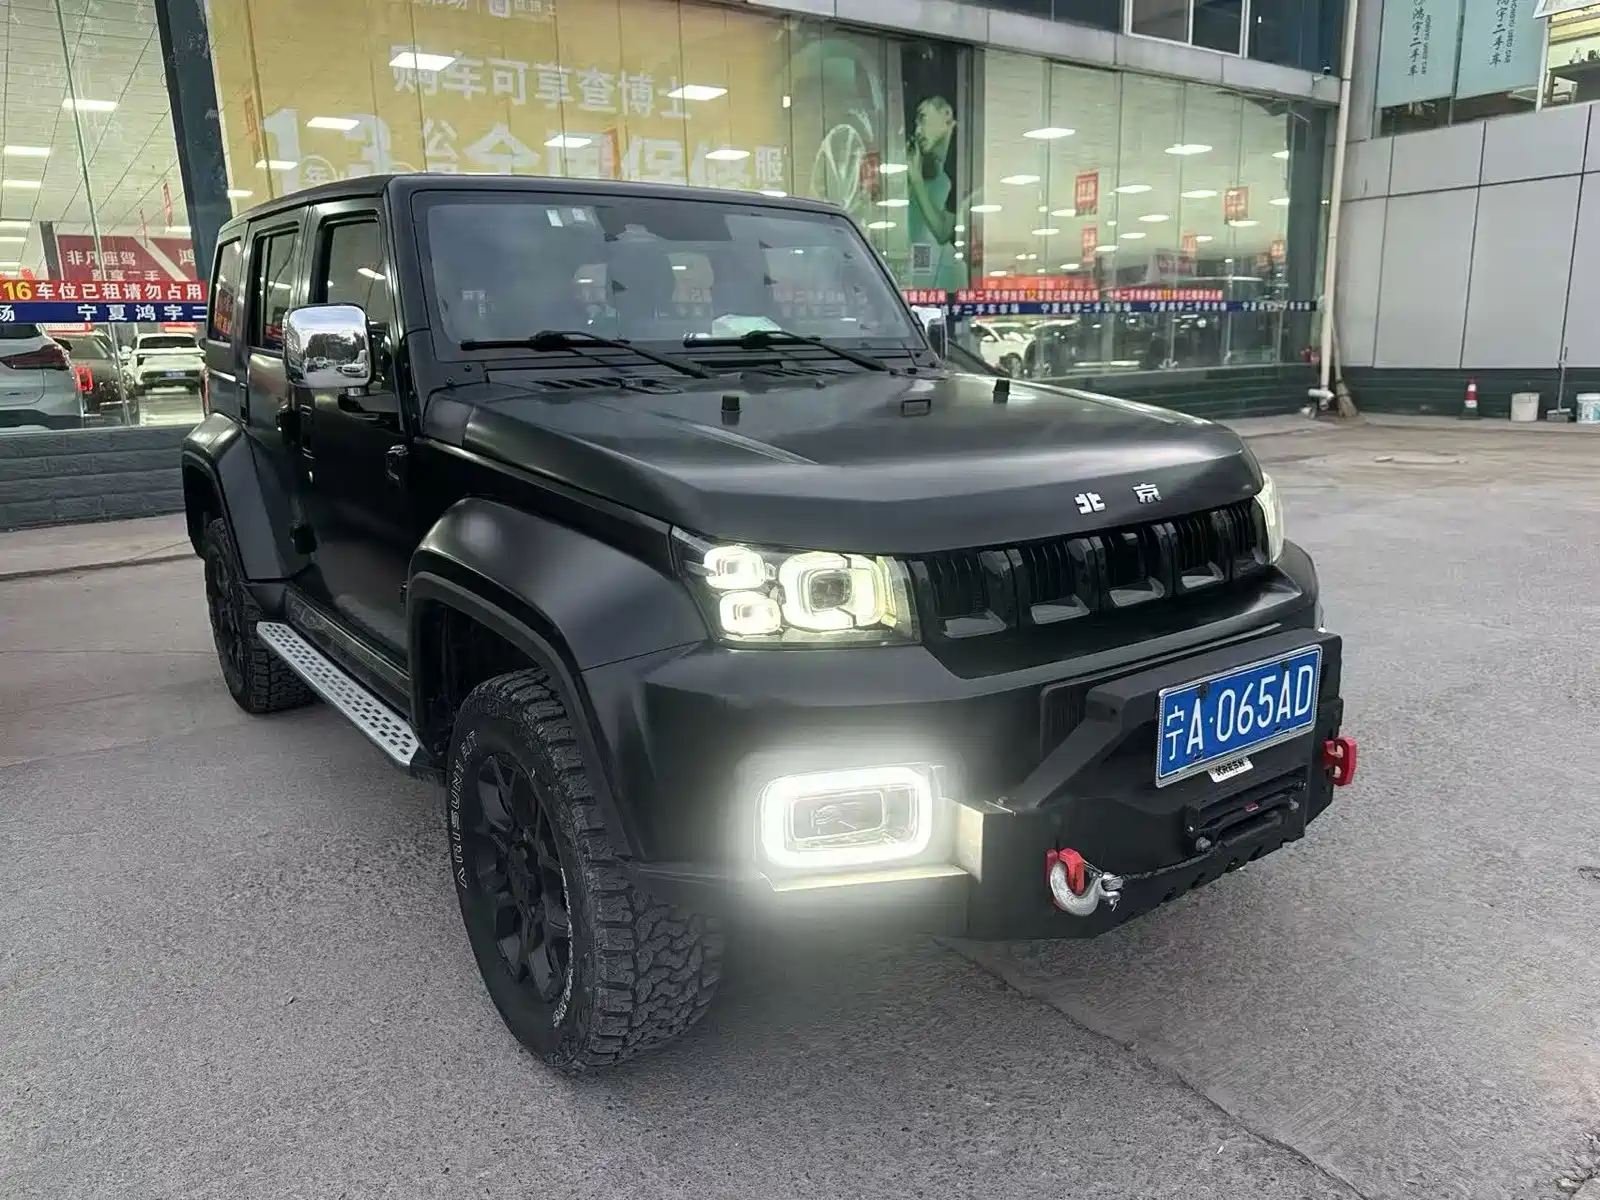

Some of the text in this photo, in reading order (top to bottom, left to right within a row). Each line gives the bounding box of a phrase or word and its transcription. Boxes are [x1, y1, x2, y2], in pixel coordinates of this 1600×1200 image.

[66, 250, 136, 266] 非凡座驾
[0, 282, 203, 301] 16车位已租请勿占用
[1075, 483, 1161, 514] 北京
